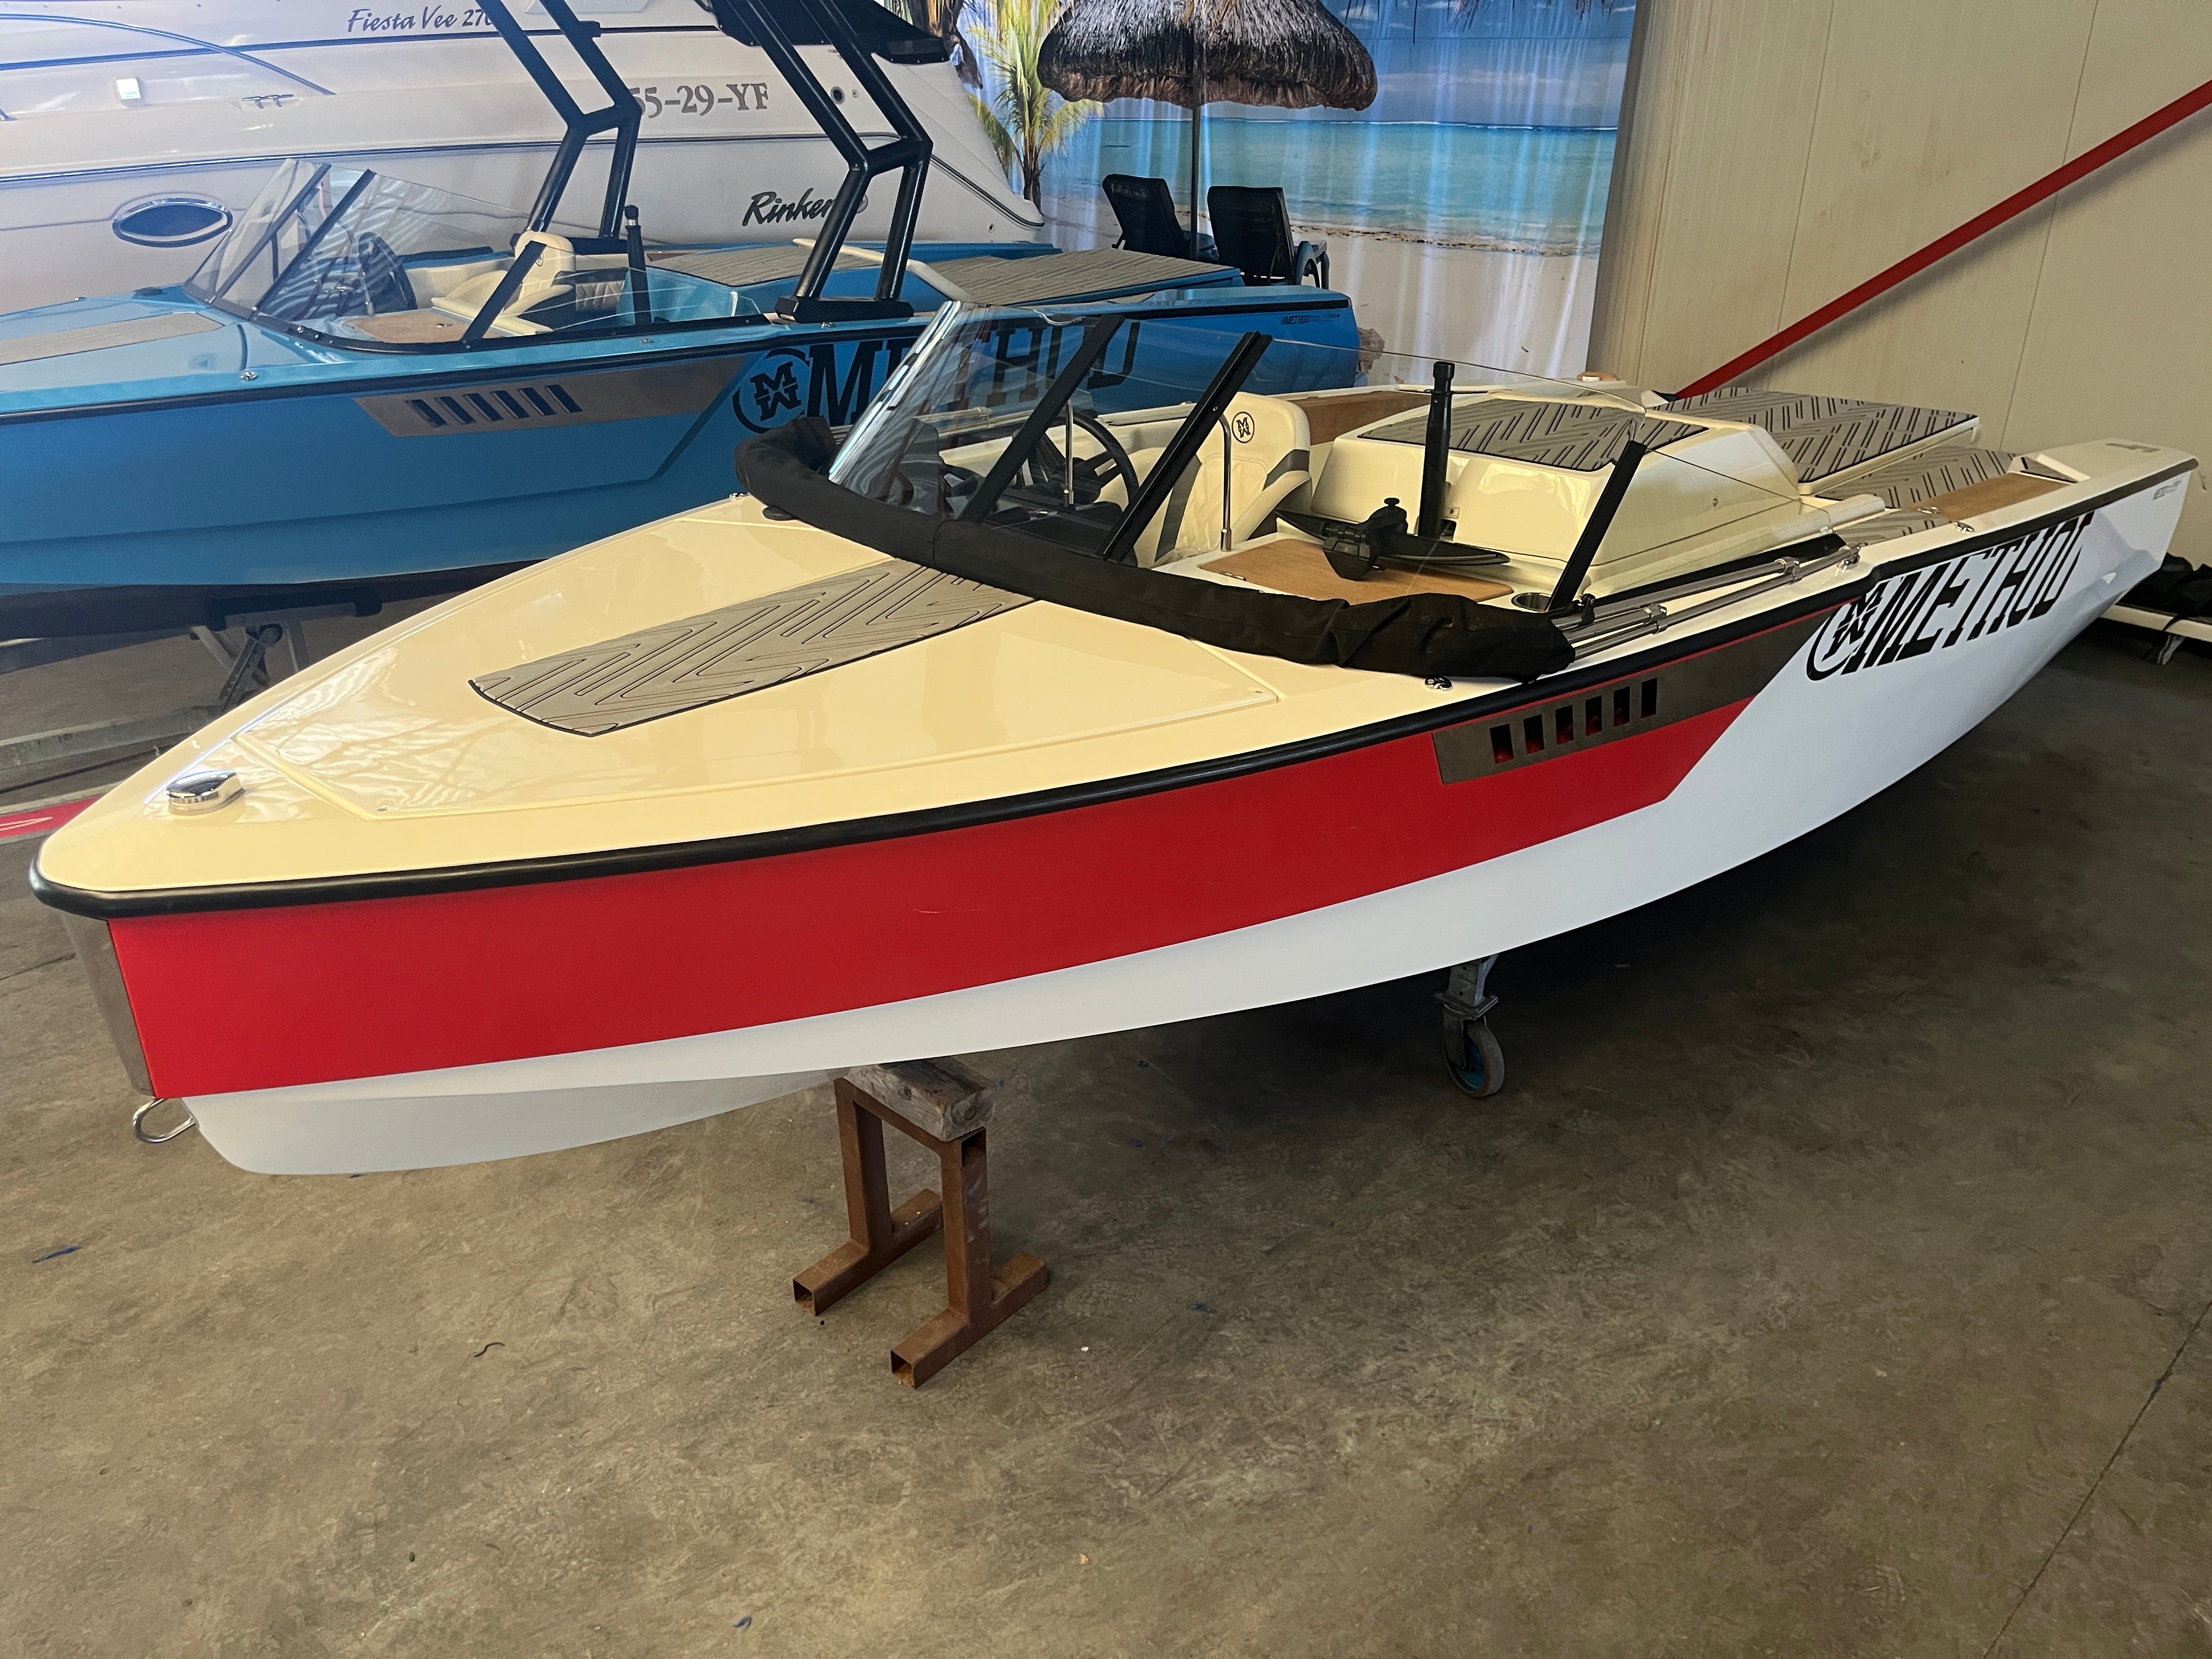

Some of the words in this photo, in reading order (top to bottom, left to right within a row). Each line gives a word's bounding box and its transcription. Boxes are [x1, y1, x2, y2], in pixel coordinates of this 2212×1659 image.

[348, 9, 415, 32] Fiesta
[422, 5, 458, 29] Vee
[742, 188, 836, 227] Rinker
[1841, 511, 2095, 675] METHOD
